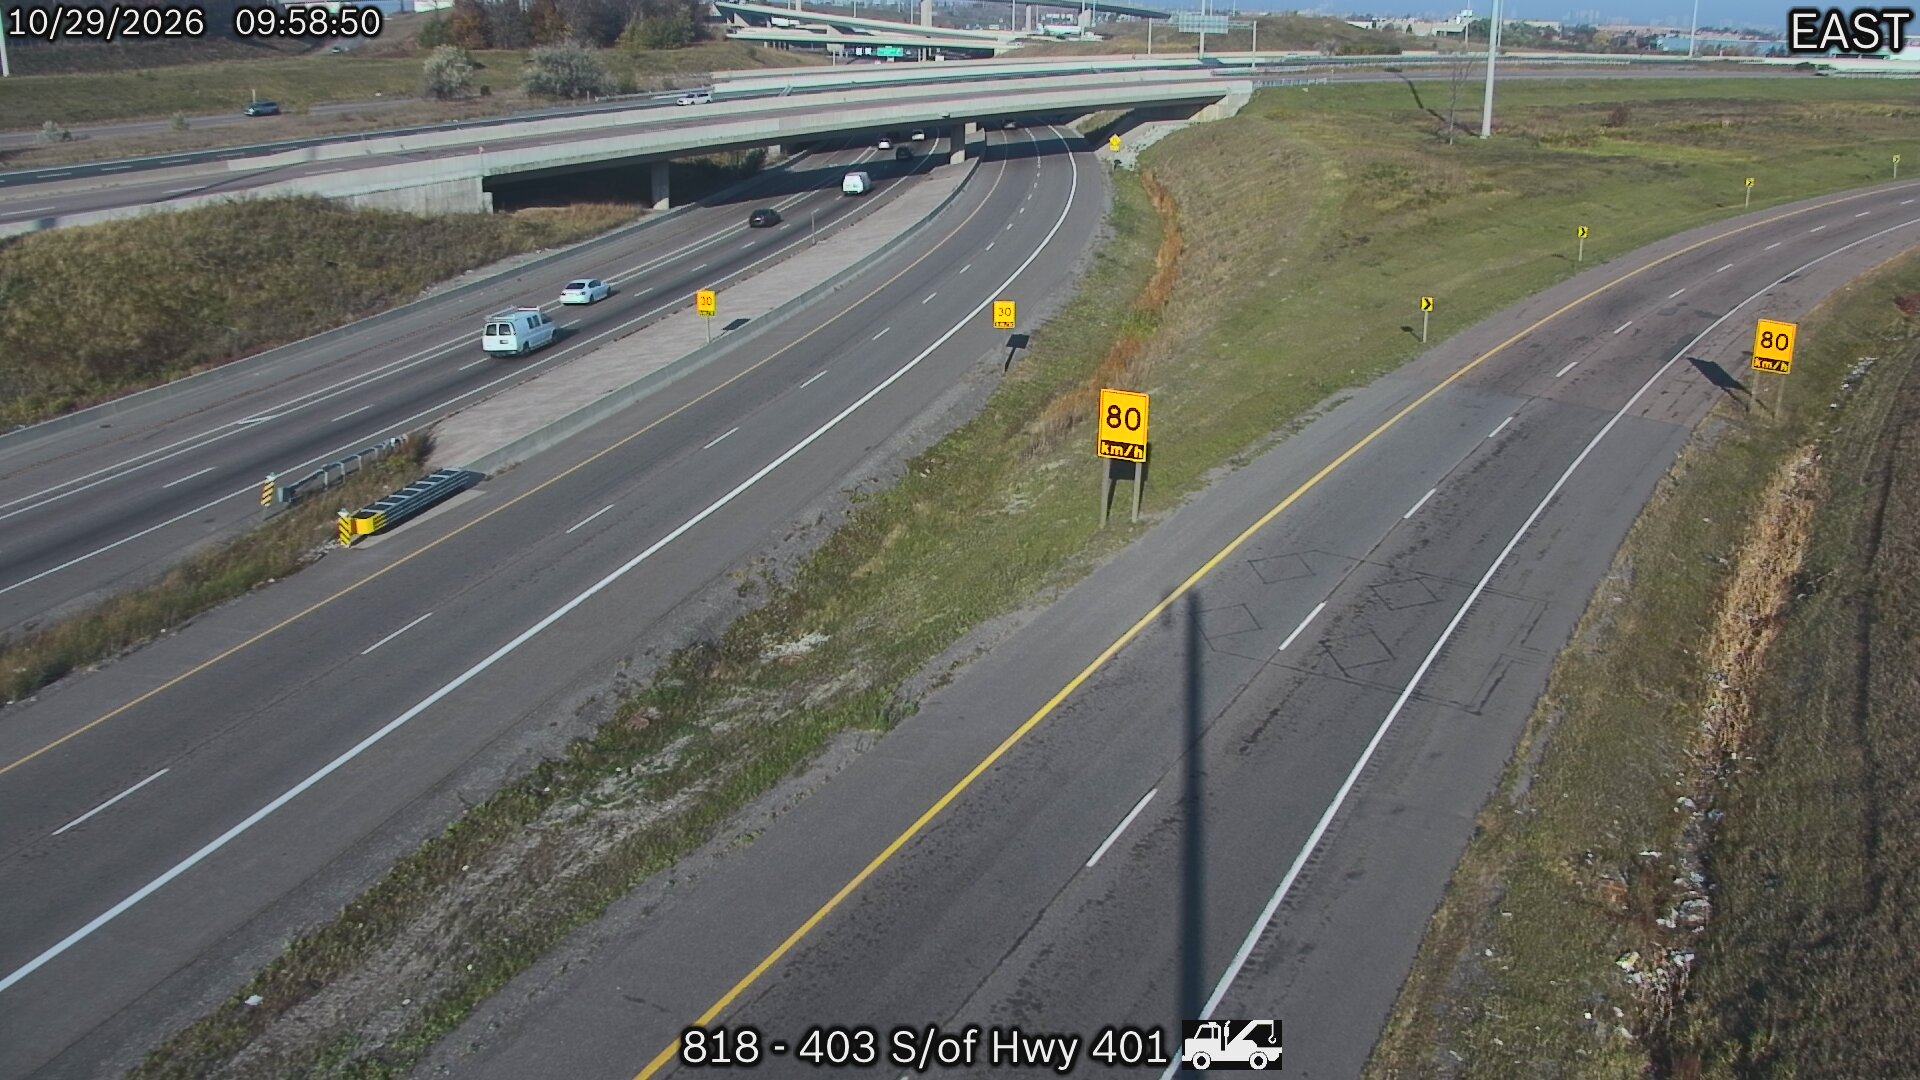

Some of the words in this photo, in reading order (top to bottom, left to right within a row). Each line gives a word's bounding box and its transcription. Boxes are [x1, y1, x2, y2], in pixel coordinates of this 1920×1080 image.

[998, 307, 1012, 317] 30
[1761, 331, 1788, 351] 80
[1754, 357, 1788, 371] km/h
[1106, 404, 1141, 432] 80
[1101, 441, 1143, 459] km/h
